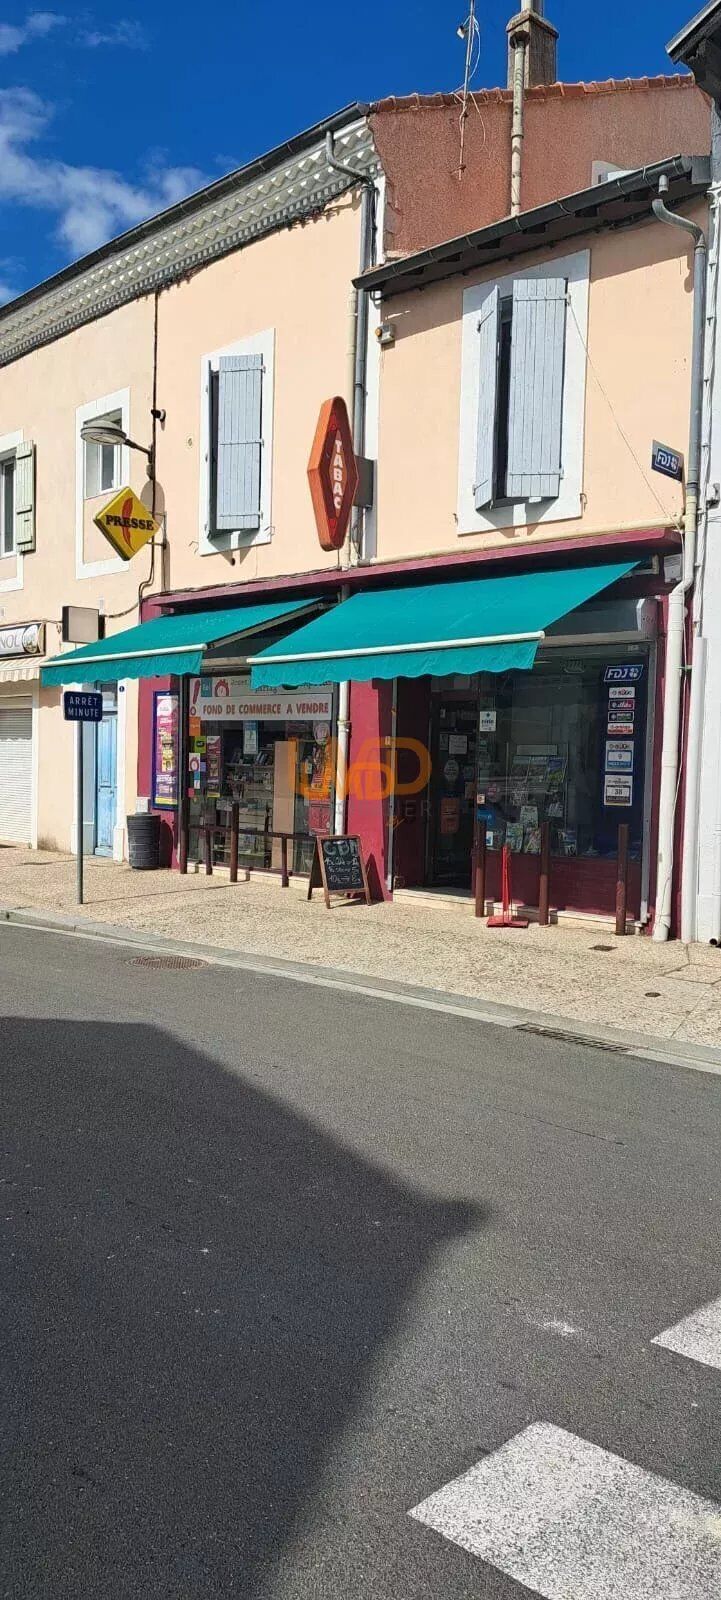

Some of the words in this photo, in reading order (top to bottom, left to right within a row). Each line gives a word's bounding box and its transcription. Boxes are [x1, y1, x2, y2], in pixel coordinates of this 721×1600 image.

[656, 452, 671, 468] FDJ
[332, 439, 344, 510] TABAC
[105, 514, 154, 531] PRESSE
[607, 668, 629, 679] FDJ
[69, 696, 98, 707] ARRÊT
[68, 707, 99, 718] MINUTE
[203, 704, 223, 715] FOND
[226, 704, 236, 715] DE
[238, 703, 282, 714] COMMERCE
[286, 703, 293, 714] A
[296, 702, 329, 714] VENDRE
